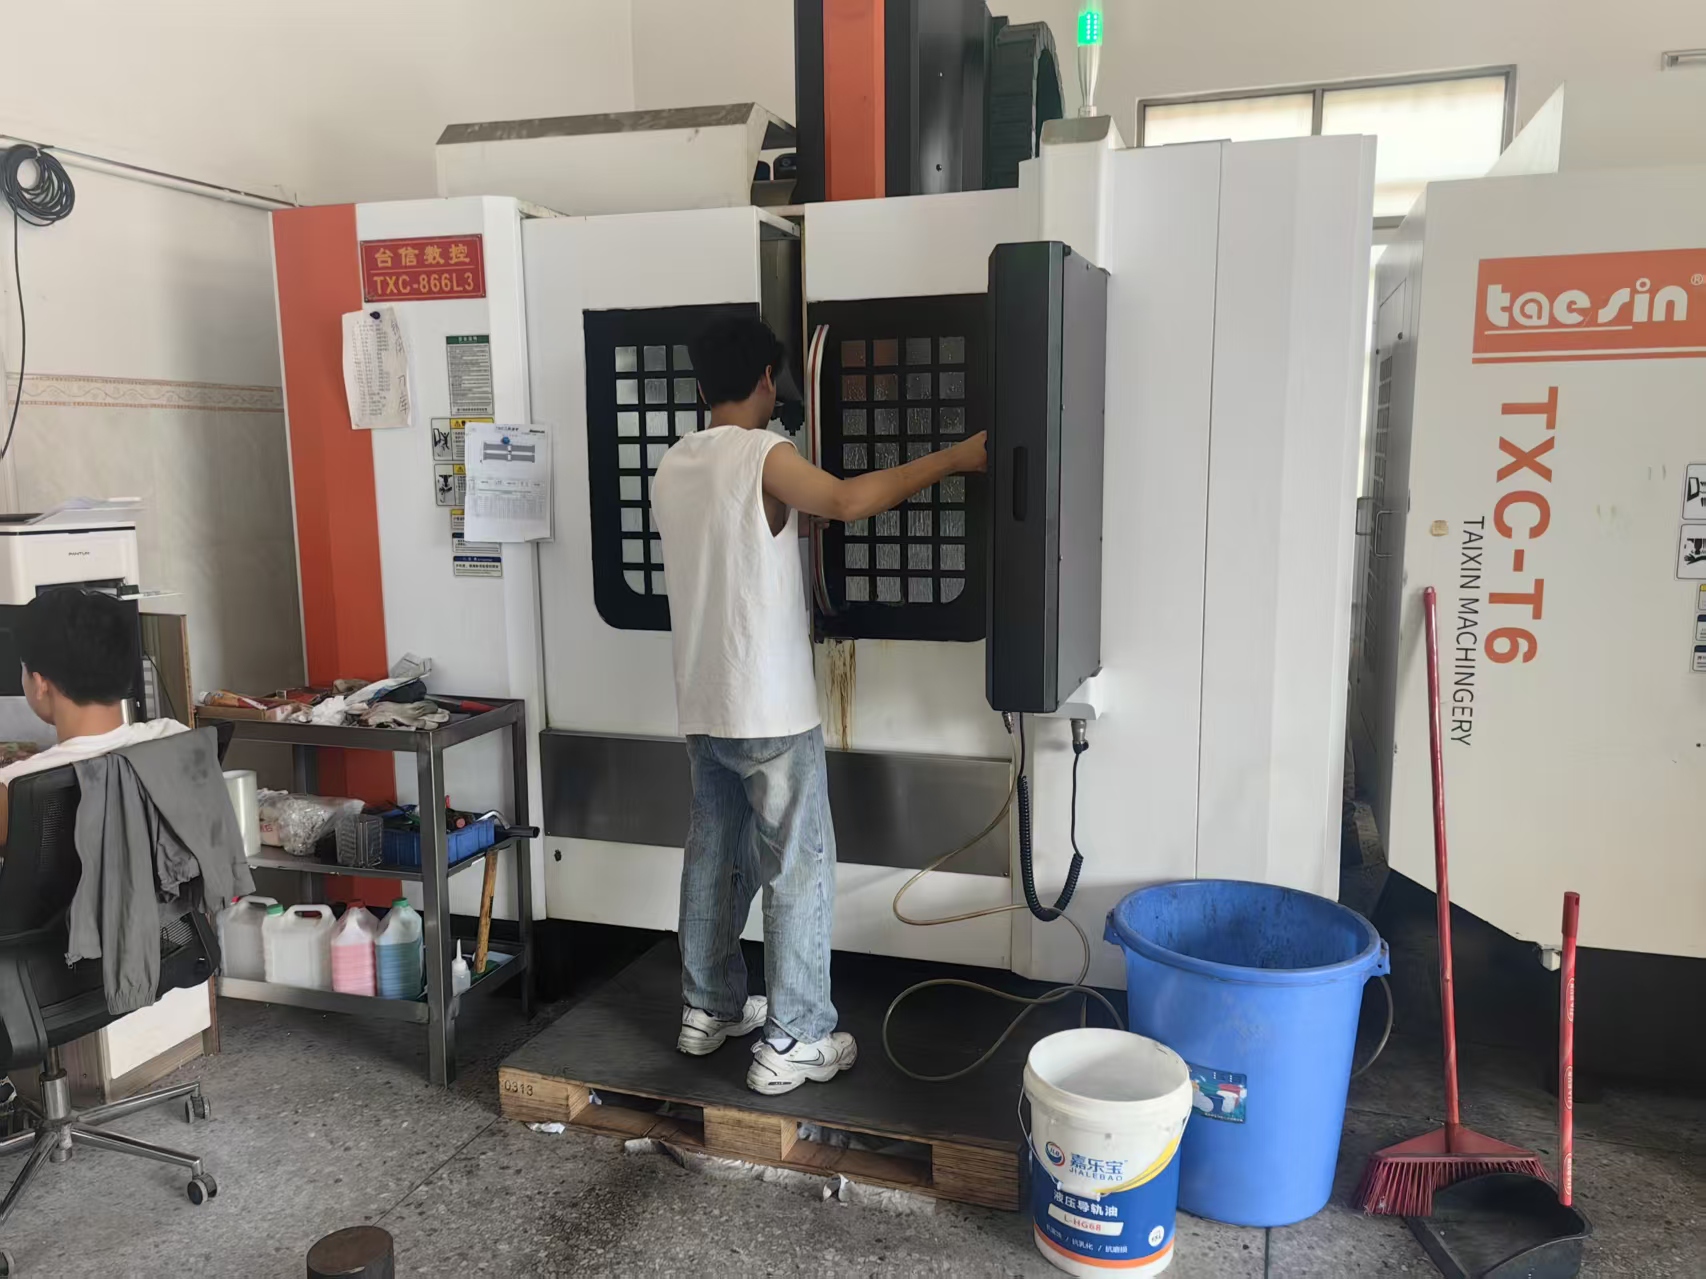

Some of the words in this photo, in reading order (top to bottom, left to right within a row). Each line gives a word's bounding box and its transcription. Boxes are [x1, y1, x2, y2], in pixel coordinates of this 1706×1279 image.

[374, 243, 471, 268] 台信数控
[373, 272, 475, 295] TXC-866L3
[1486, 277, 1689, 329] taesin
[1483, 386, 1559, 664] TXC-T6
[1460, 516, 1485, 590] TAIXIN
[1450, 597, 1481, 747] MACHINGERY
[504, 1080, 534, 1097] 0313
[1069, 1167, 1123, 1182] JIALEBAO
[1070, 1152, 1124, 1175] 嘉乐宝
[1053, 1189, 1119, 1217] 液压导轨油
